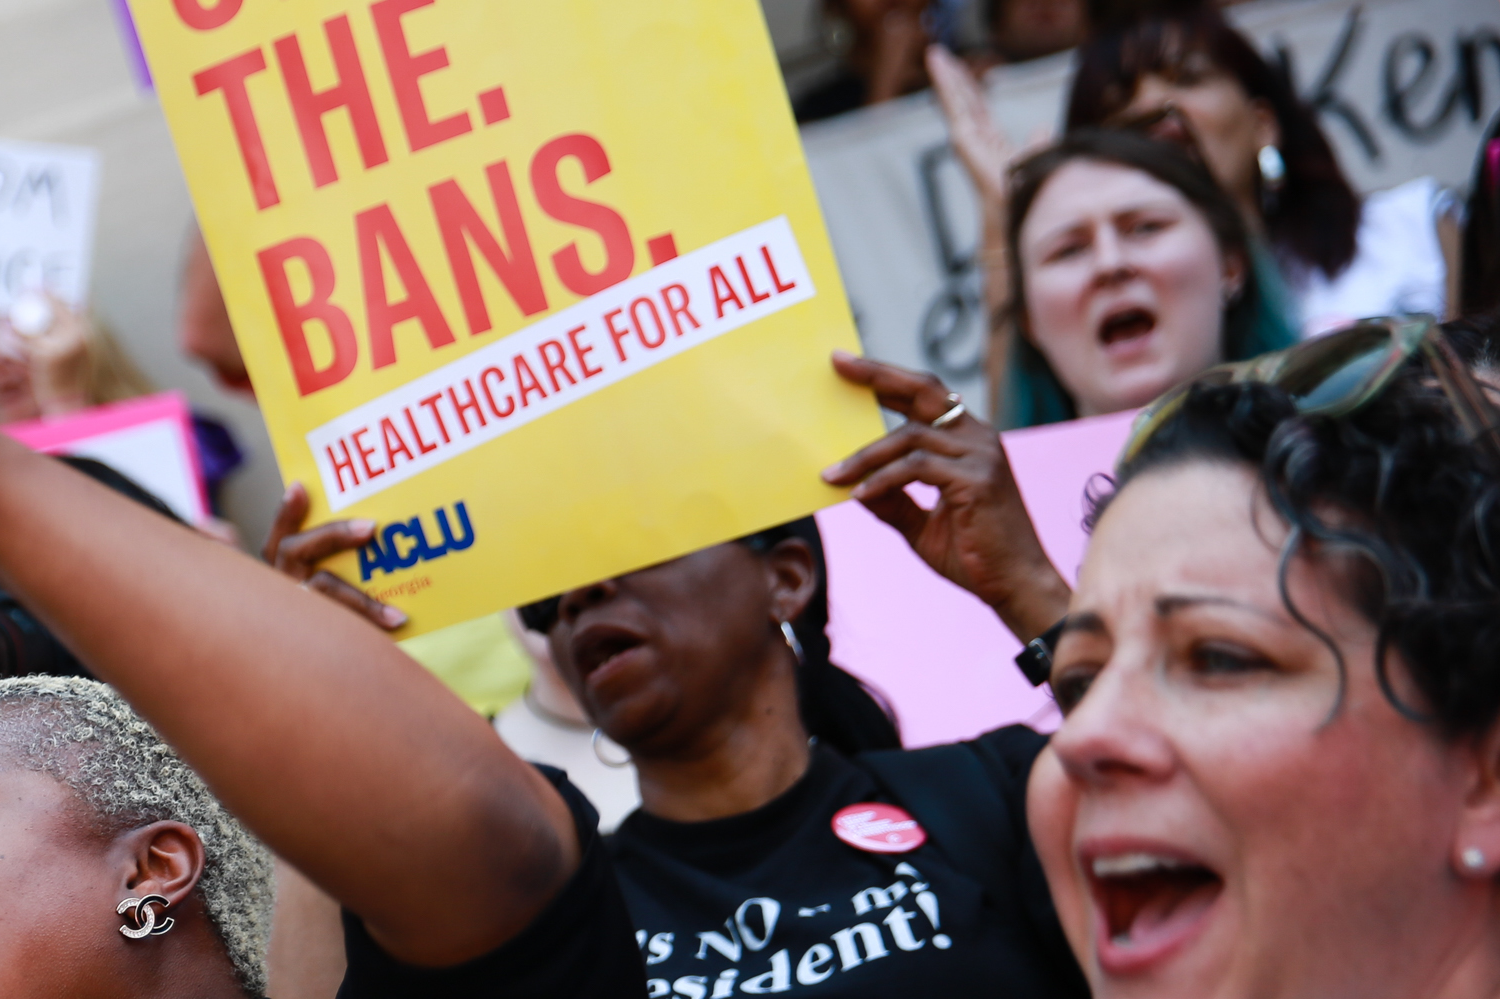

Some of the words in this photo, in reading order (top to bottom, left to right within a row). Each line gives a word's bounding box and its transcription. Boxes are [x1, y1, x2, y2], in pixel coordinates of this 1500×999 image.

[192, 0, 511, 213] THE.
[255, 132, 679, 398] BANS.
[324, 324, 603, 495] HEALTHCARE
[603, 283, 702, 363] FOR
[708, 245, 797, 319] ALL
[357, 500, 475, 583] ACLU
